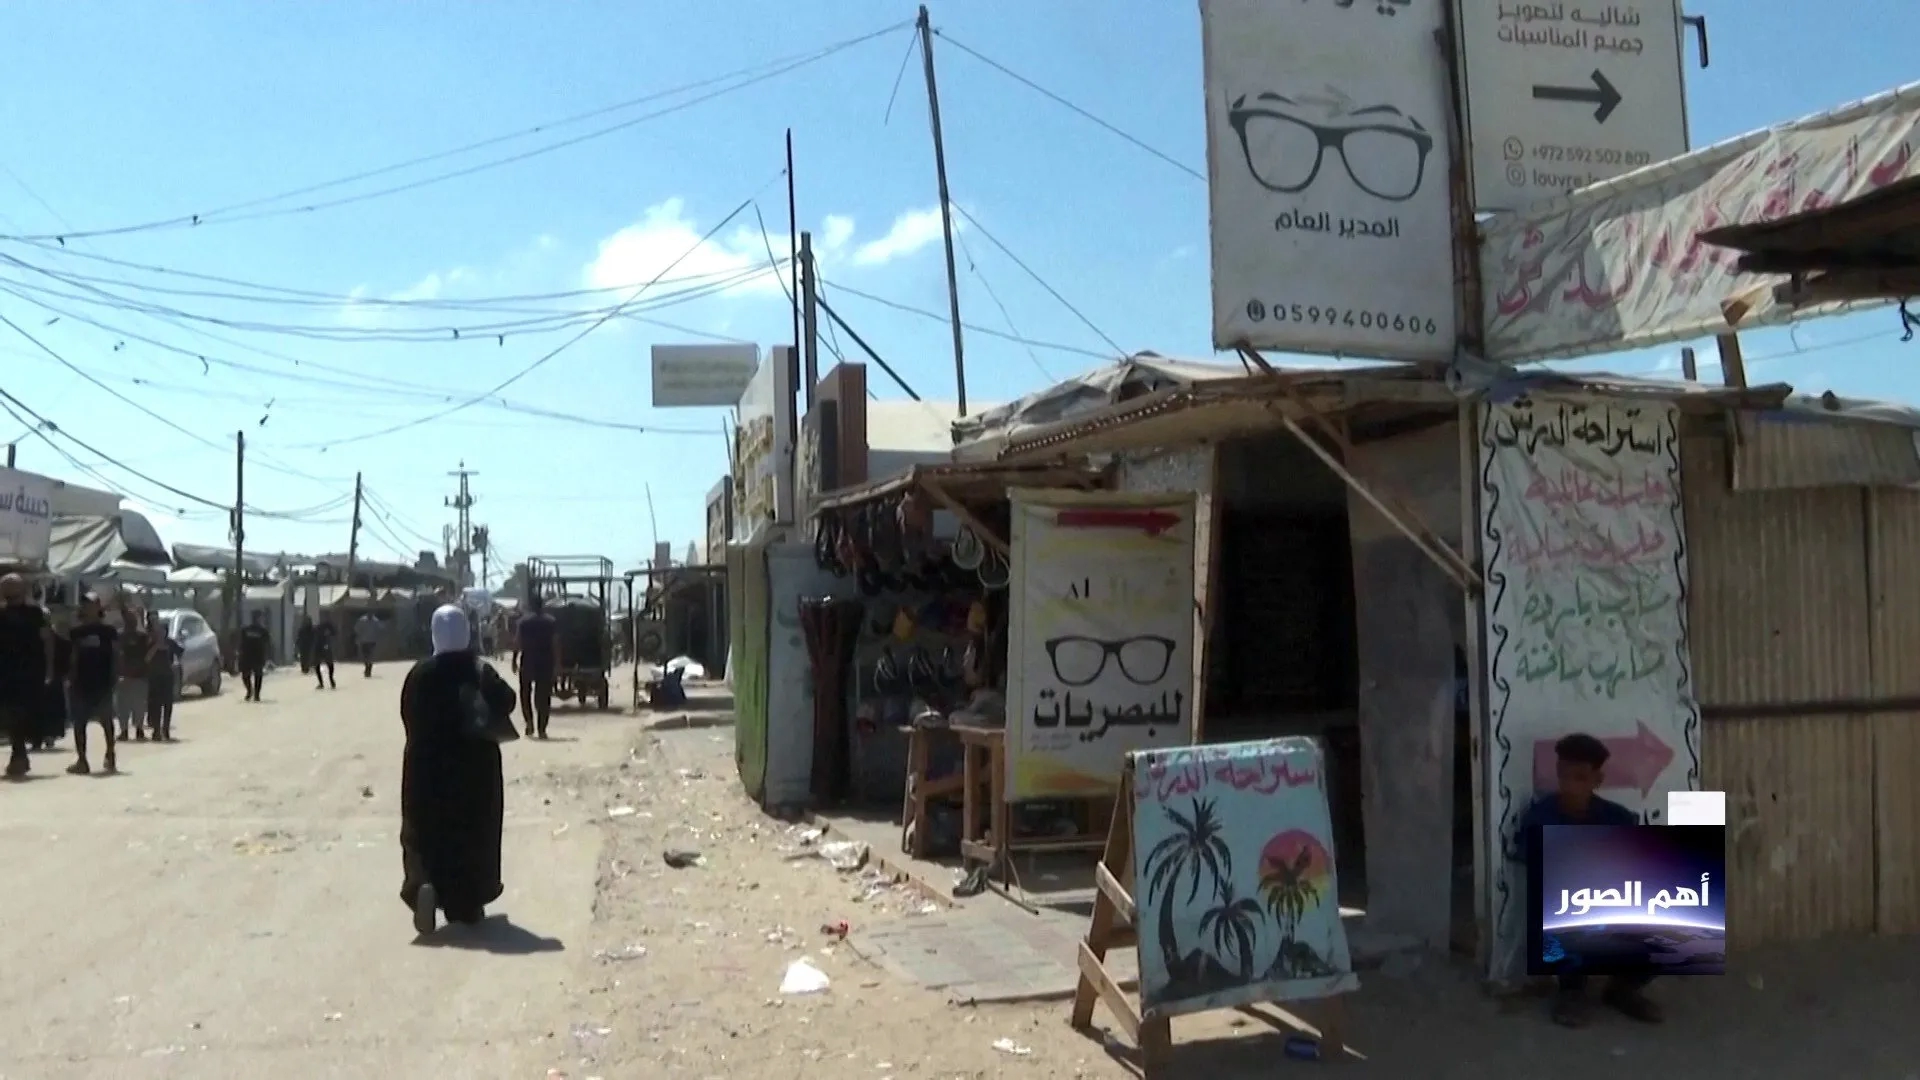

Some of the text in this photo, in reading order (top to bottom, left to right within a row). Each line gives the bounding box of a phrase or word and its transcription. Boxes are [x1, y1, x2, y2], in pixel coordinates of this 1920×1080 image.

[1497, 23, 1588, 50] المناسبات
[1532, 144, 1563, 161] +972
[1275, 208, 1400, 238] المدير العام
[1273, 303, 1437, 335] 0599400606
[1573, 405, 1662, 458] استراحة
[1033, 688, 1183, 743] للبصريات
